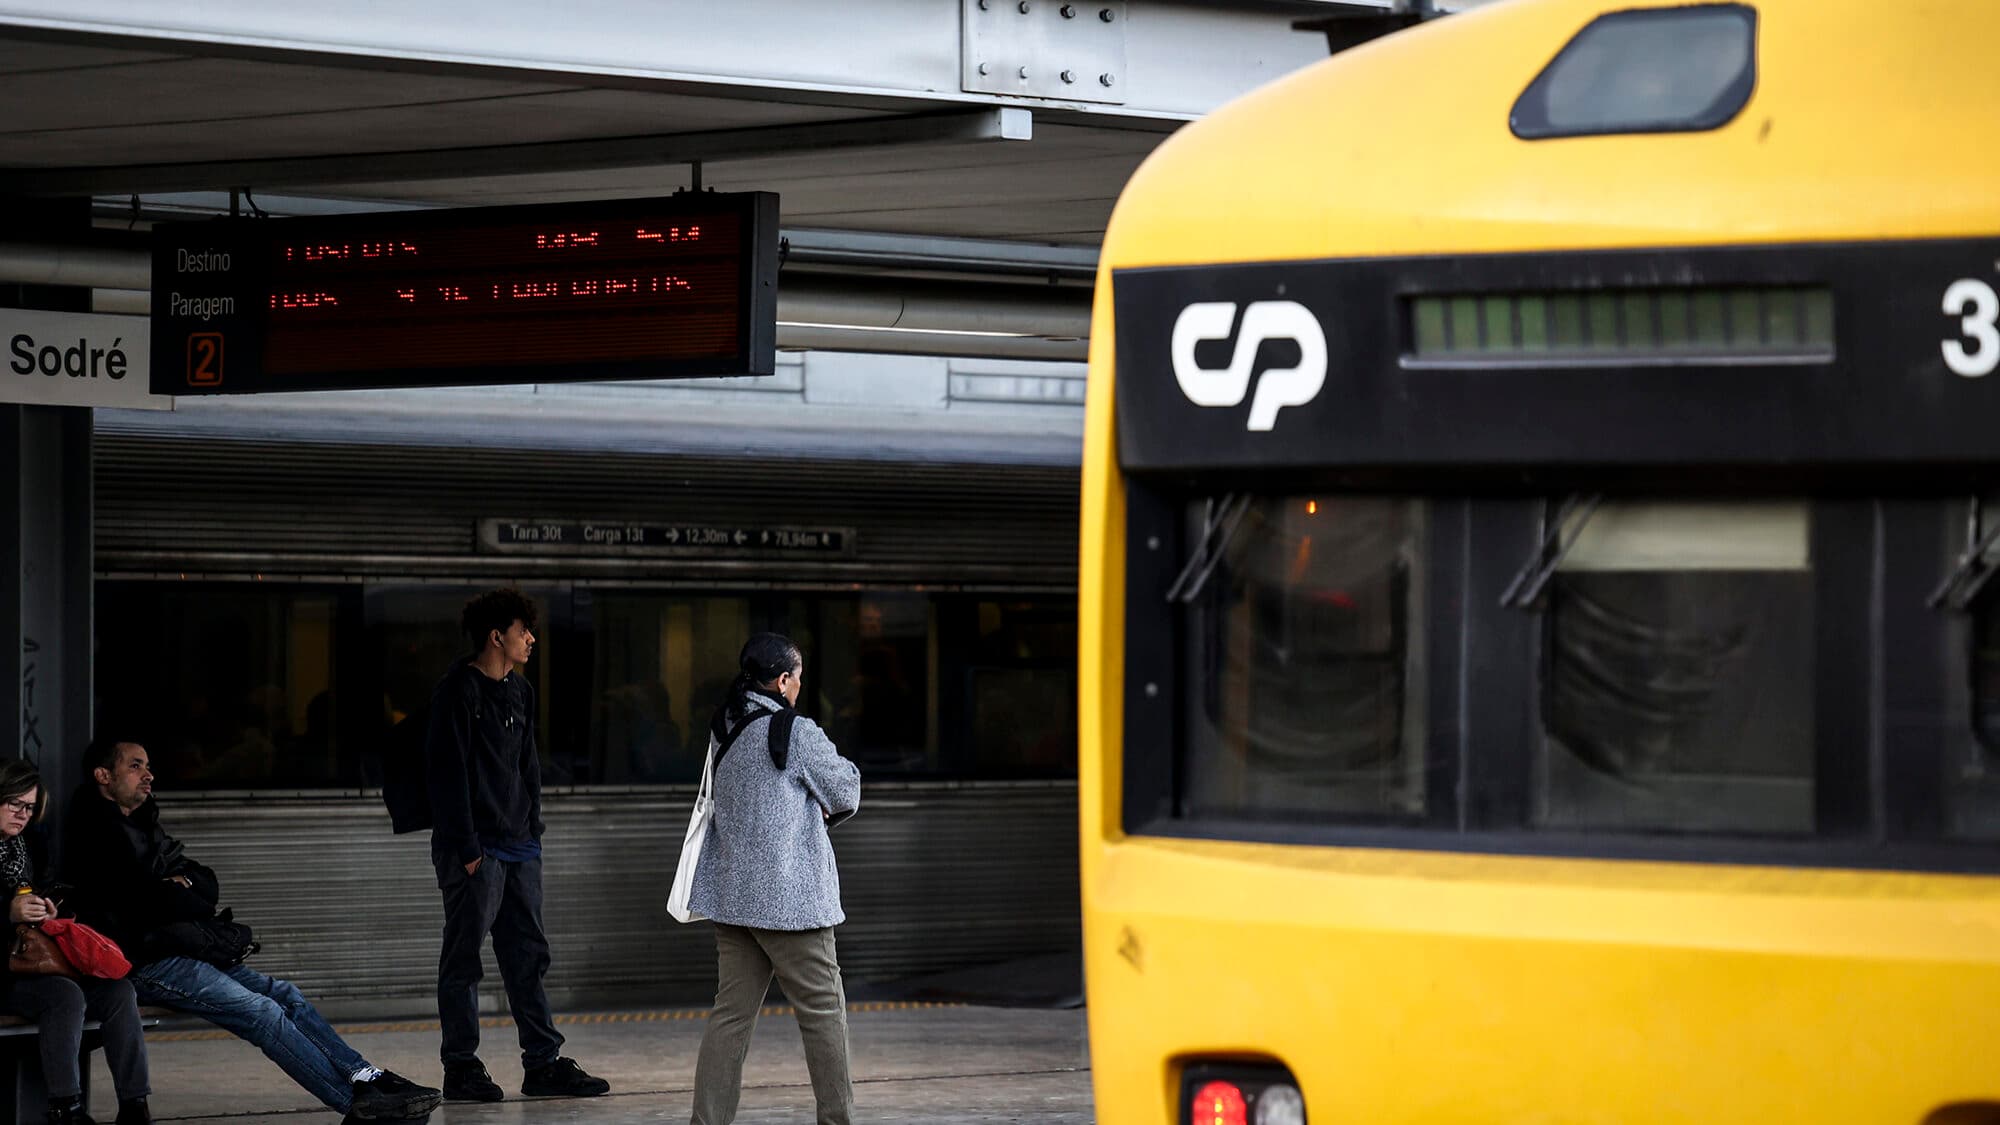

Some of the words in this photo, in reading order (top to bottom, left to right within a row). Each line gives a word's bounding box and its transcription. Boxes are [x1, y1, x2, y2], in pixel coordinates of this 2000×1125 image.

[177, 247, 231, 273] Destino
[170, 291, 234, 320] Paragem
[1941, 278, 2000, 377] 3
[10, 333, 127, 380] Sodré
[196, 338, 216, 380] 2
[510, 524, 539, 540] Tara
[543, 526, 562, 541] 30t
[584, 525, 621, 545] Carga
